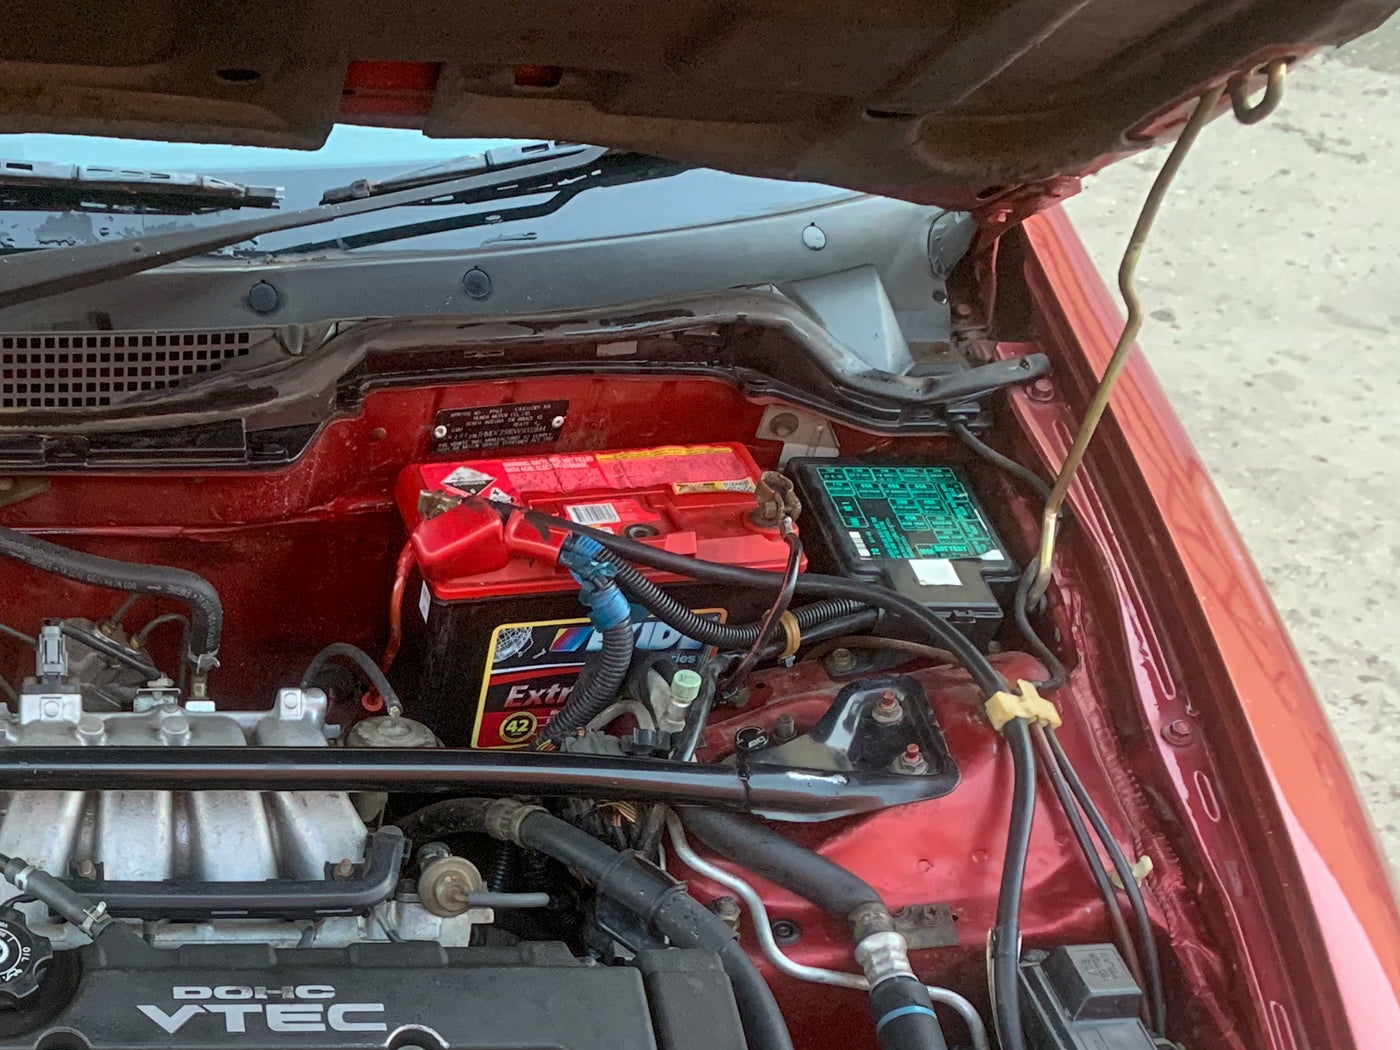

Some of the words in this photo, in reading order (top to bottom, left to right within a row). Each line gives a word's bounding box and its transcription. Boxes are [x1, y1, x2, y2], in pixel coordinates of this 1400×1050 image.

[504, 683, 575, 708] Extr
[505, 719, 530, 733] 42
[21, 946, 31, 962] OIL
[172, 984, 336, 1000] DOHC
[135, 1003, 388, 1034] VTEC
